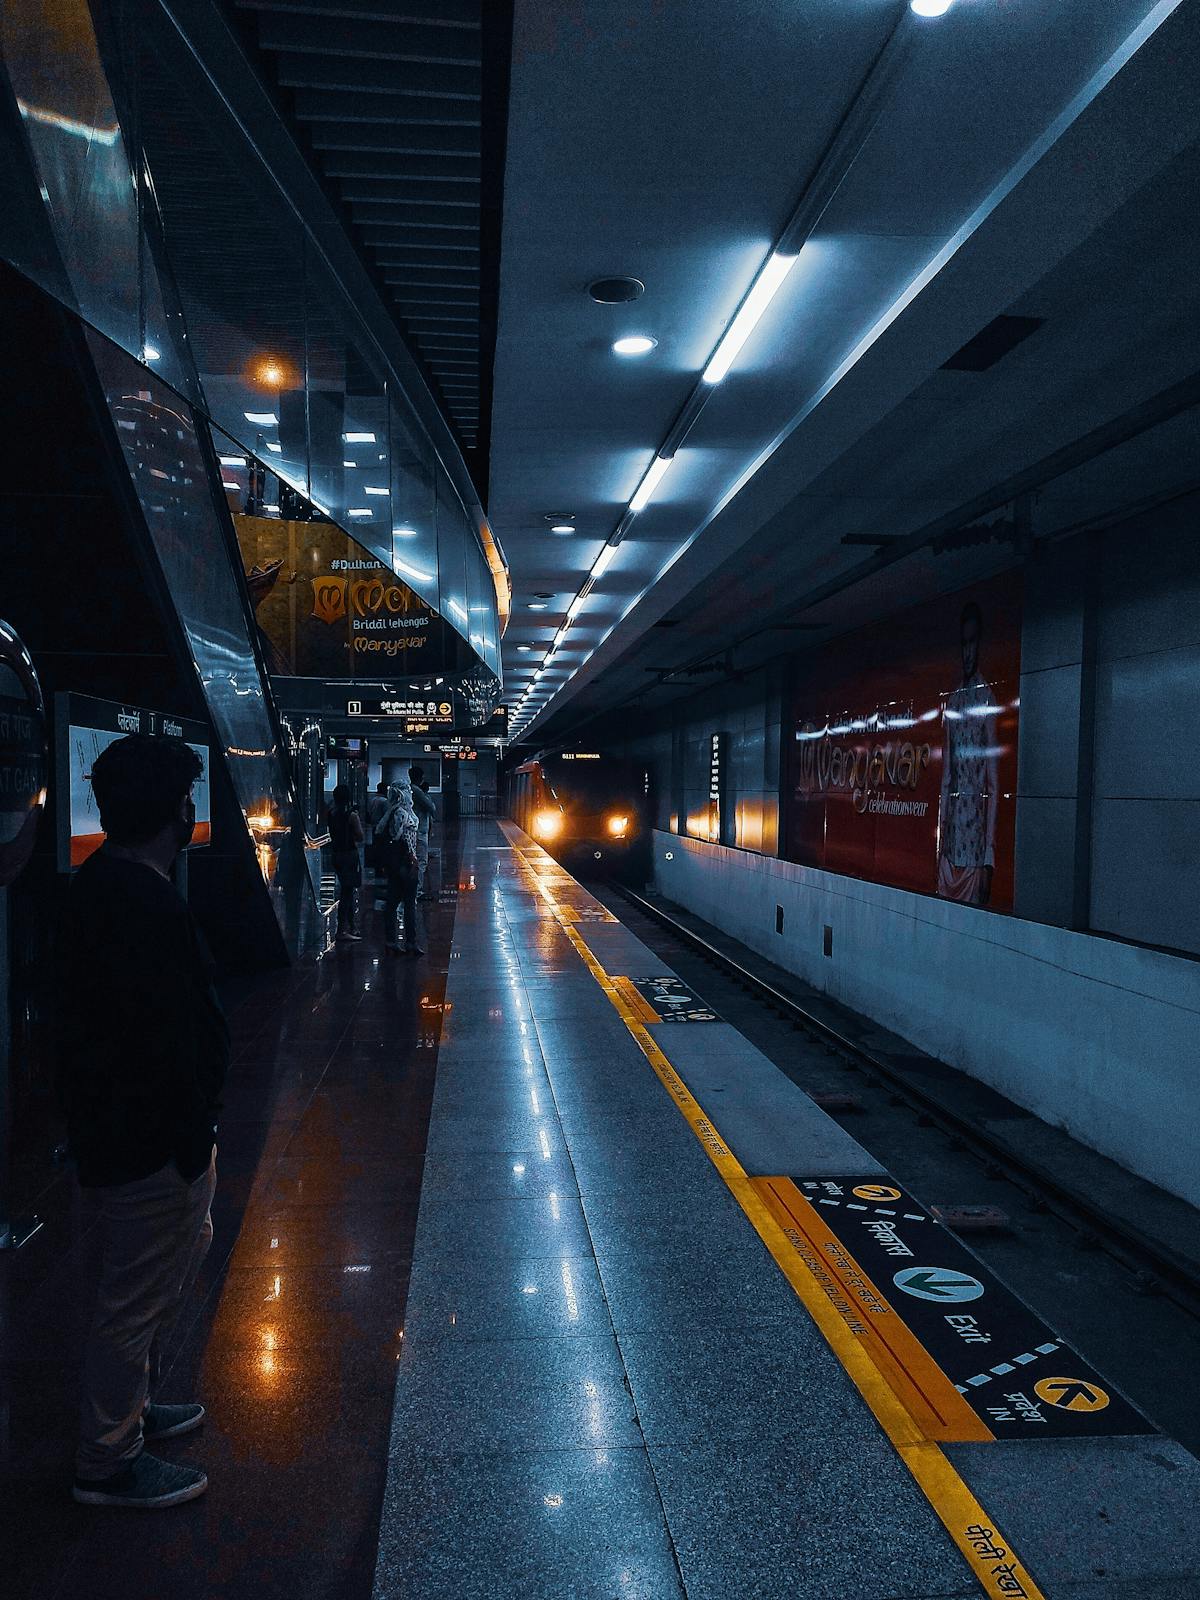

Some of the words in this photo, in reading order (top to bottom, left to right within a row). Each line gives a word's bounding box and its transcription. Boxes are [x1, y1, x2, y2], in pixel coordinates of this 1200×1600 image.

[353, 618, 387, 631] Bridal
[353, 635, 427, 657] Manyavar
[861, 1219, 915, 1258] निकास
[943, 1313, 993, 1345] Exit
[985, 1406, 1017, 1422] IN
[1002, 1390, 1048, 1424] प्रवेश
[964, 1524, 1007, 1560] पीली
